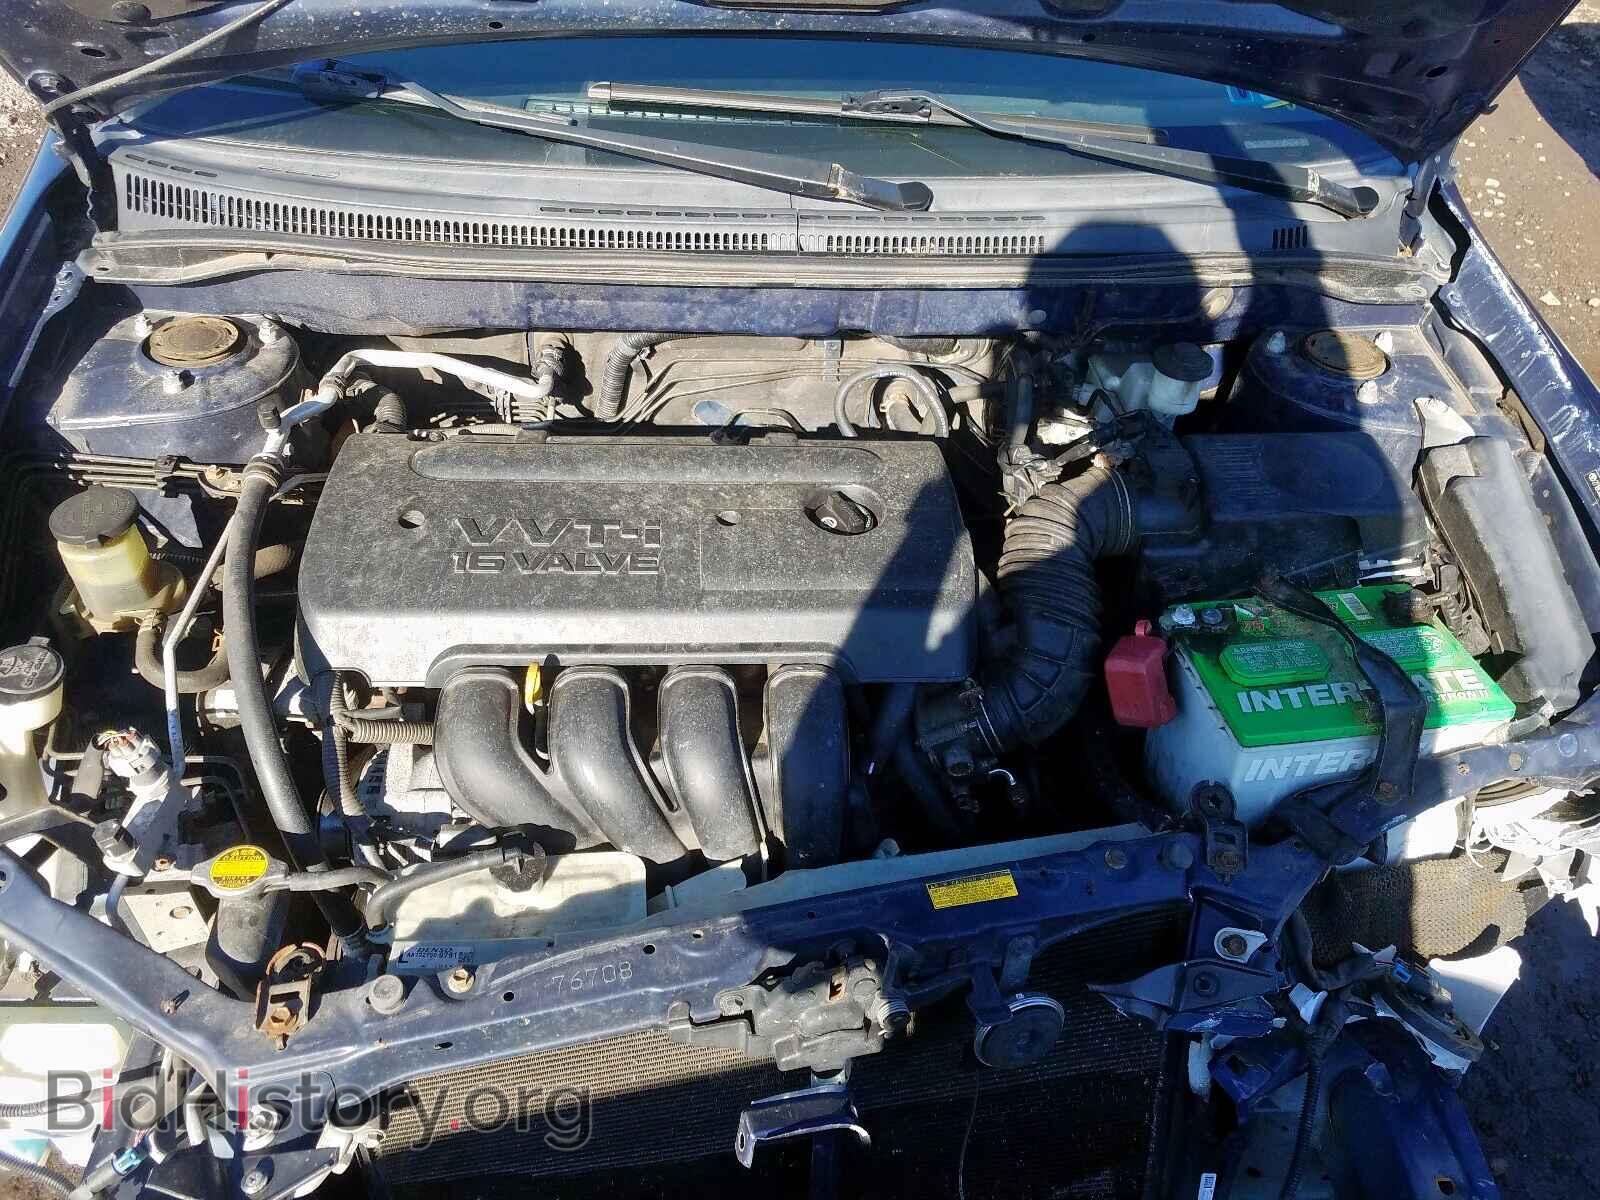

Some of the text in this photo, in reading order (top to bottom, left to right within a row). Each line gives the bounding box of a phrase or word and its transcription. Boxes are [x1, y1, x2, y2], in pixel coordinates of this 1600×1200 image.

[454, 517, 662, 548] VVT-i
[453, 551, 661, 575] 16 VALVE
[1236, 667, 1486, 714] INTERATE
